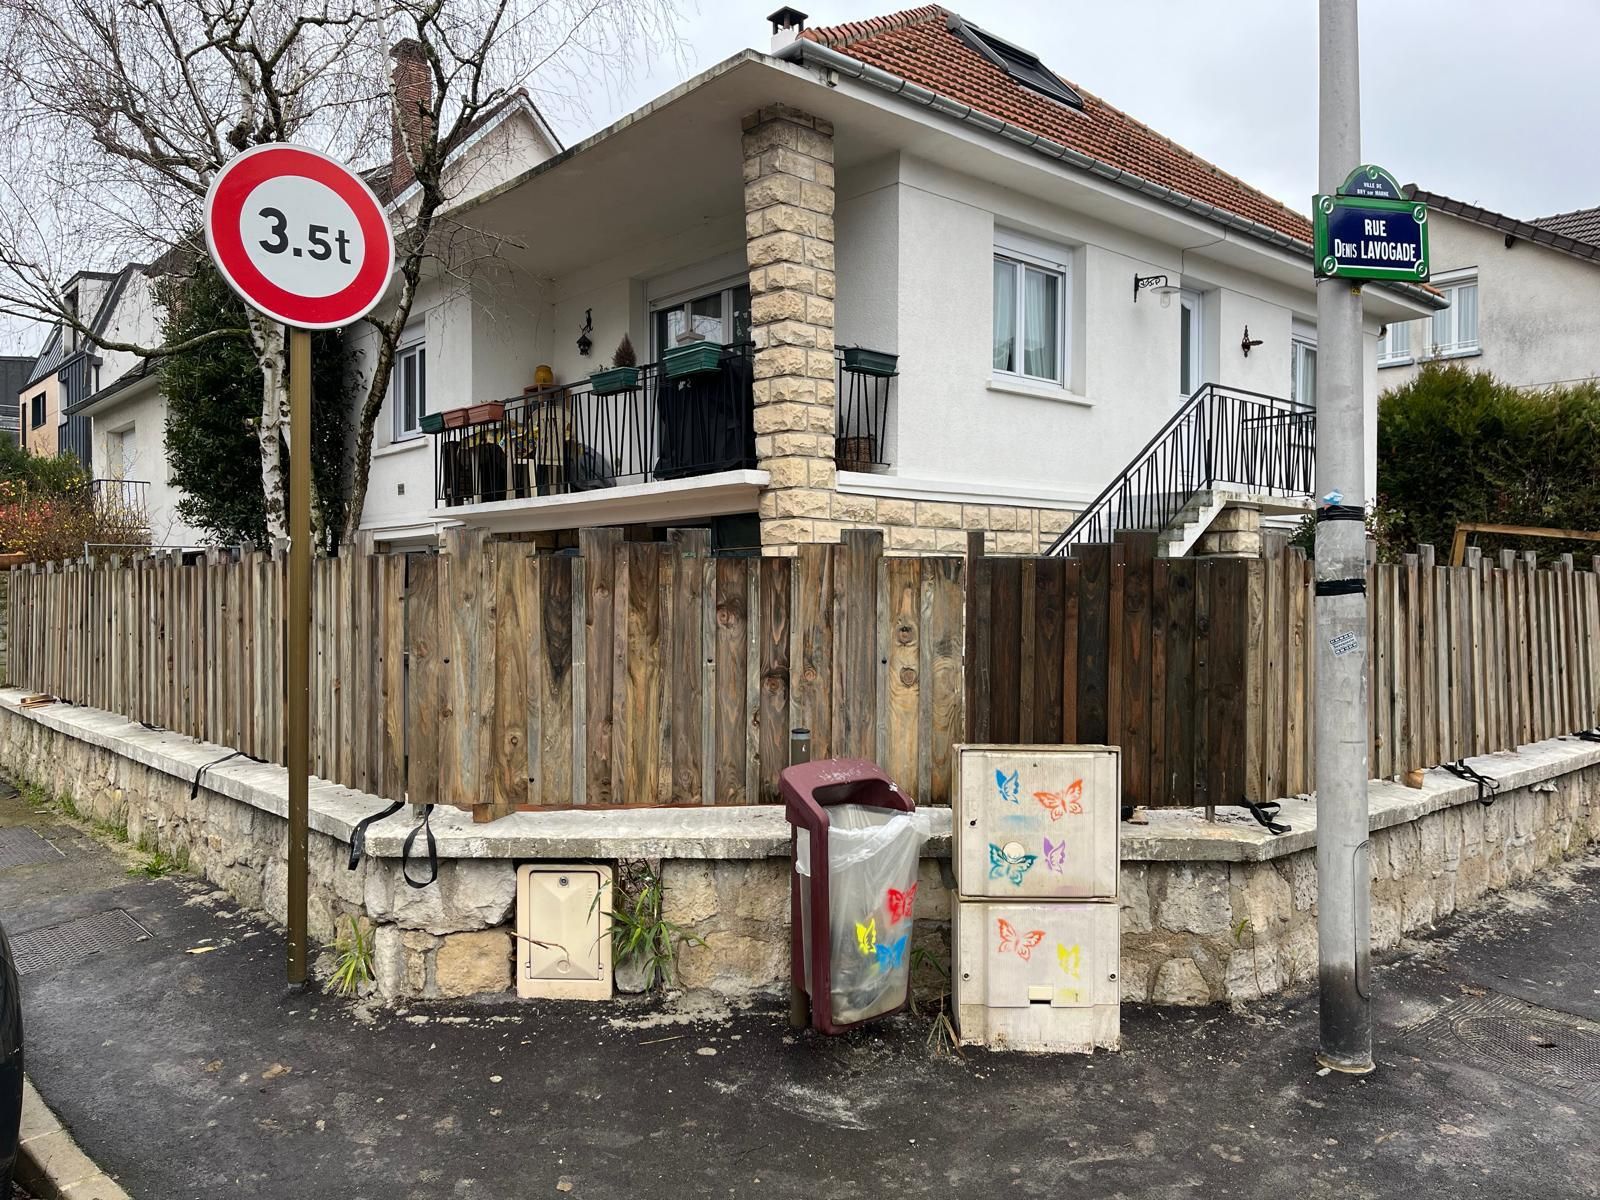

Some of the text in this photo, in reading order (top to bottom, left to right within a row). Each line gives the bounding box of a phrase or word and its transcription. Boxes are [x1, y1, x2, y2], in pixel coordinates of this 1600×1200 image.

[258, 207, 352, 265] 3.5t
[1364, 219, 1387, 236] RUE
[1334, 238, 1417, 261] DENIS LAVOGADE
